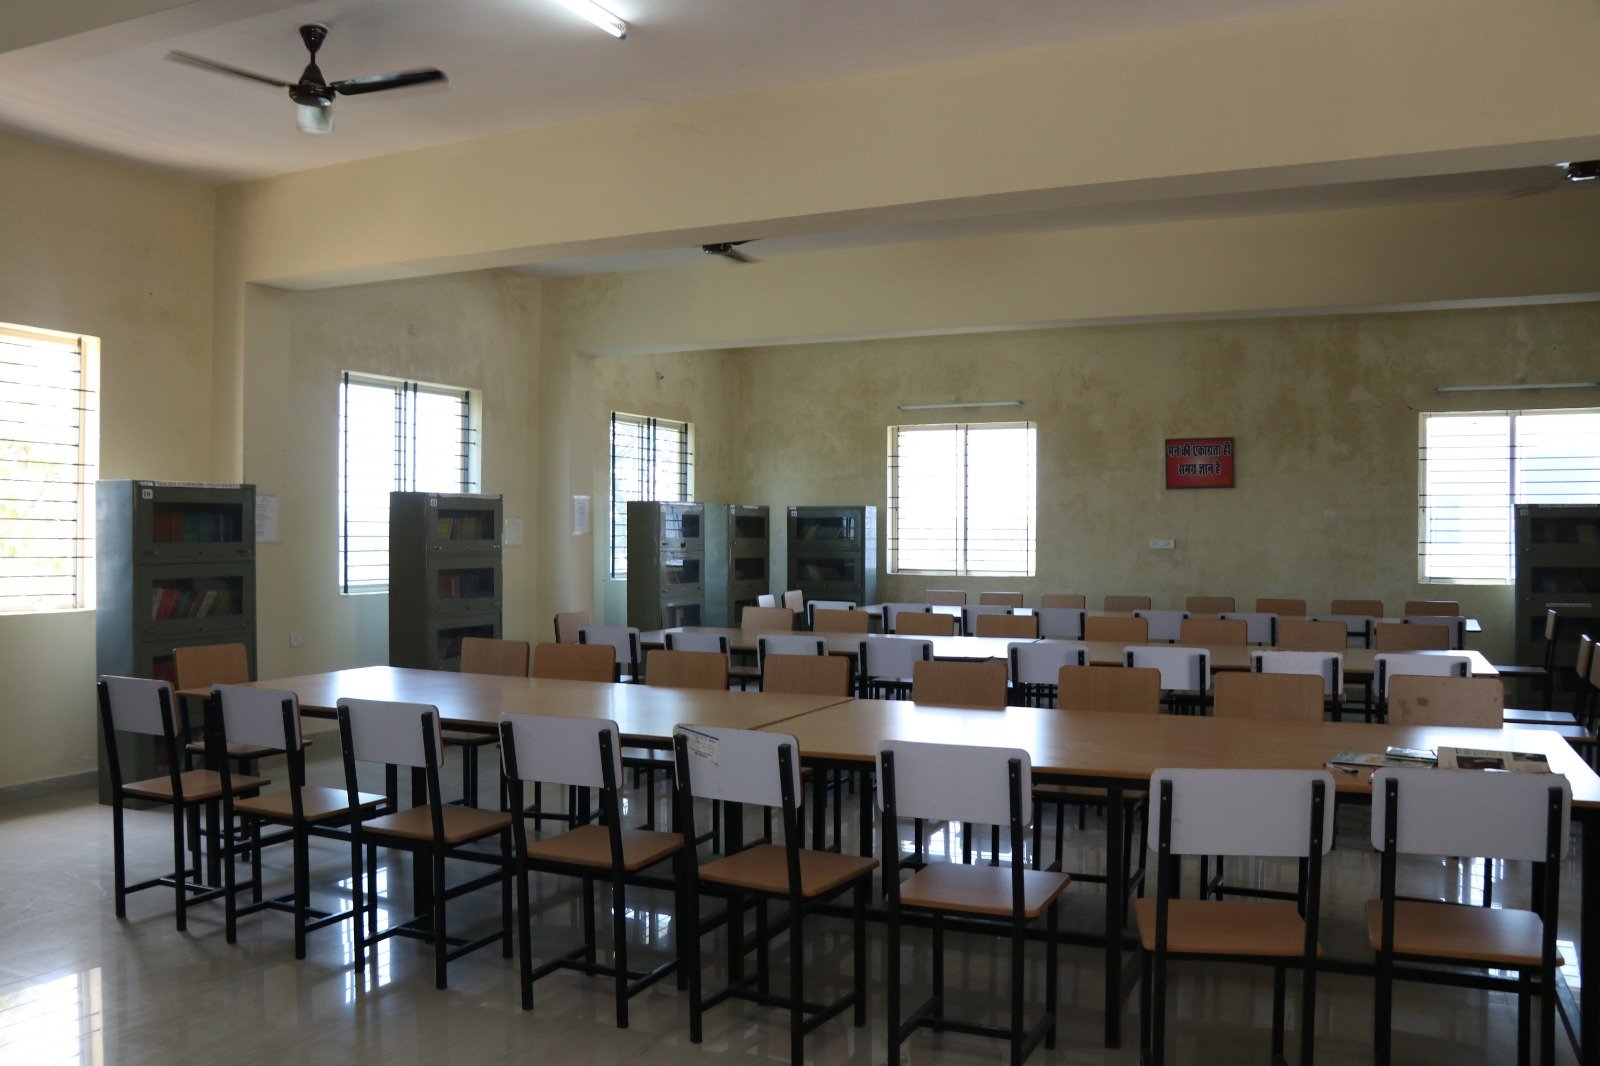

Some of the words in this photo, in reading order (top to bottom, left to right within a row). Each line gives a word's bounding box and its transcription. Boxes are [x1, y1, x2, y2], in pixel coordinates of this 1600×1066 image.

[1168, 445, 1179, 457] मन
[1182, 442, 1191, 456] की
[1193, 444, 1221, 456] एकाग्रता
[1223, 441, 1231, 456] ही
[1178, 463, 1197, 475] समग्र
[1198, 463, 1213, 475] ज्ञान
[1215, 459, 1222, 474] है
